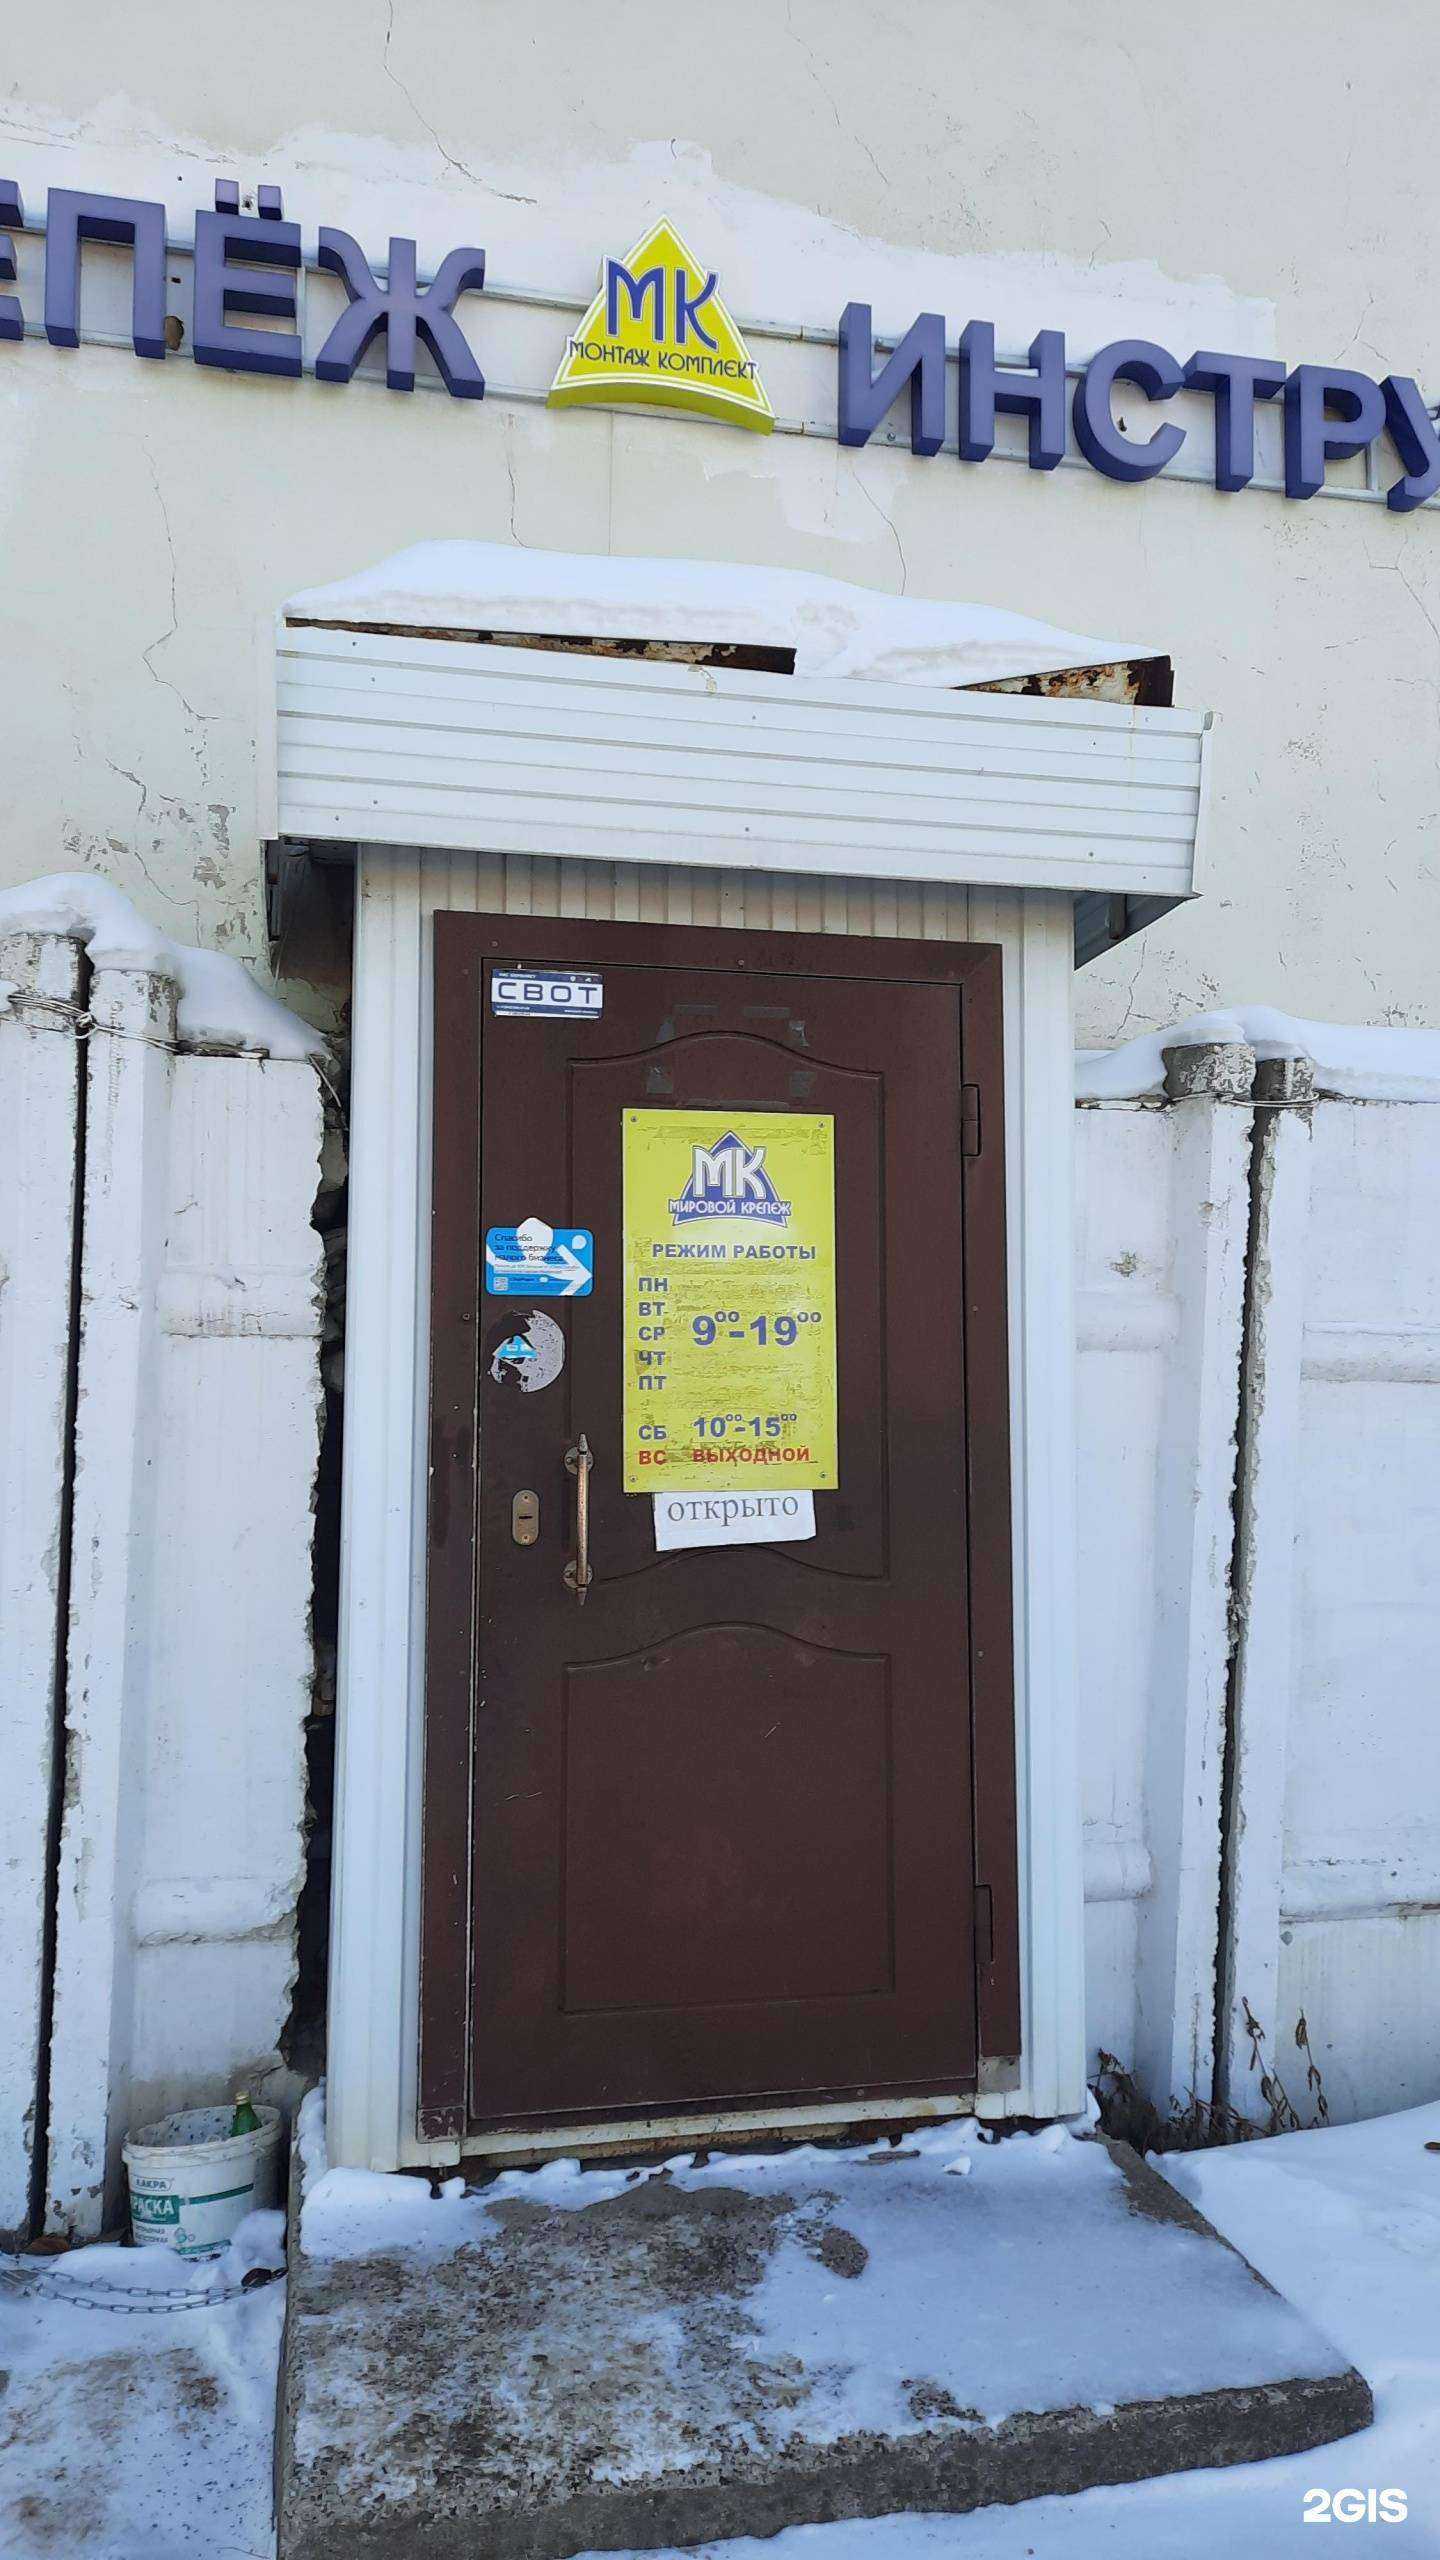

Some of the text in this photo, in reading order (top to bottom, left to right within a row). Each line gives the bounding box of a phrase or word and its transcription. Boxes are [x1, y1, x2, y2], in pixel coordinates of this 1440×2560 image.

[0, 178, 485, 399] ПЁЖ
[606, 258, 719, 351] МК
[569, 340, 757, 380] МОНТАЖ КОМПЛЕКТ
[692, 1146, 767, 1199] МК
[669, 1199, 792, 1216] МИРОВОЙ КРЕПЕЖ
[494, 1233, 533, 1242] Спасибо
[652, 1243, 816, 1260] РЕЖИМ РАБОТЫ
[638, 1277, 668, 1292] ПН
[638, 1301, 666, 1316] ВТ
[638, 1326, 666, 1341] СР
[638, 1351, 666, 1366] ЧТ
[638, 1375, 667, 1390] ПТ
[638, 1425, 667, 1440] СБ
[638, 1445, 810, 1465] ВС ВЫХОДНОЙ
[131, 2196, 175, 2216] РАСКА
